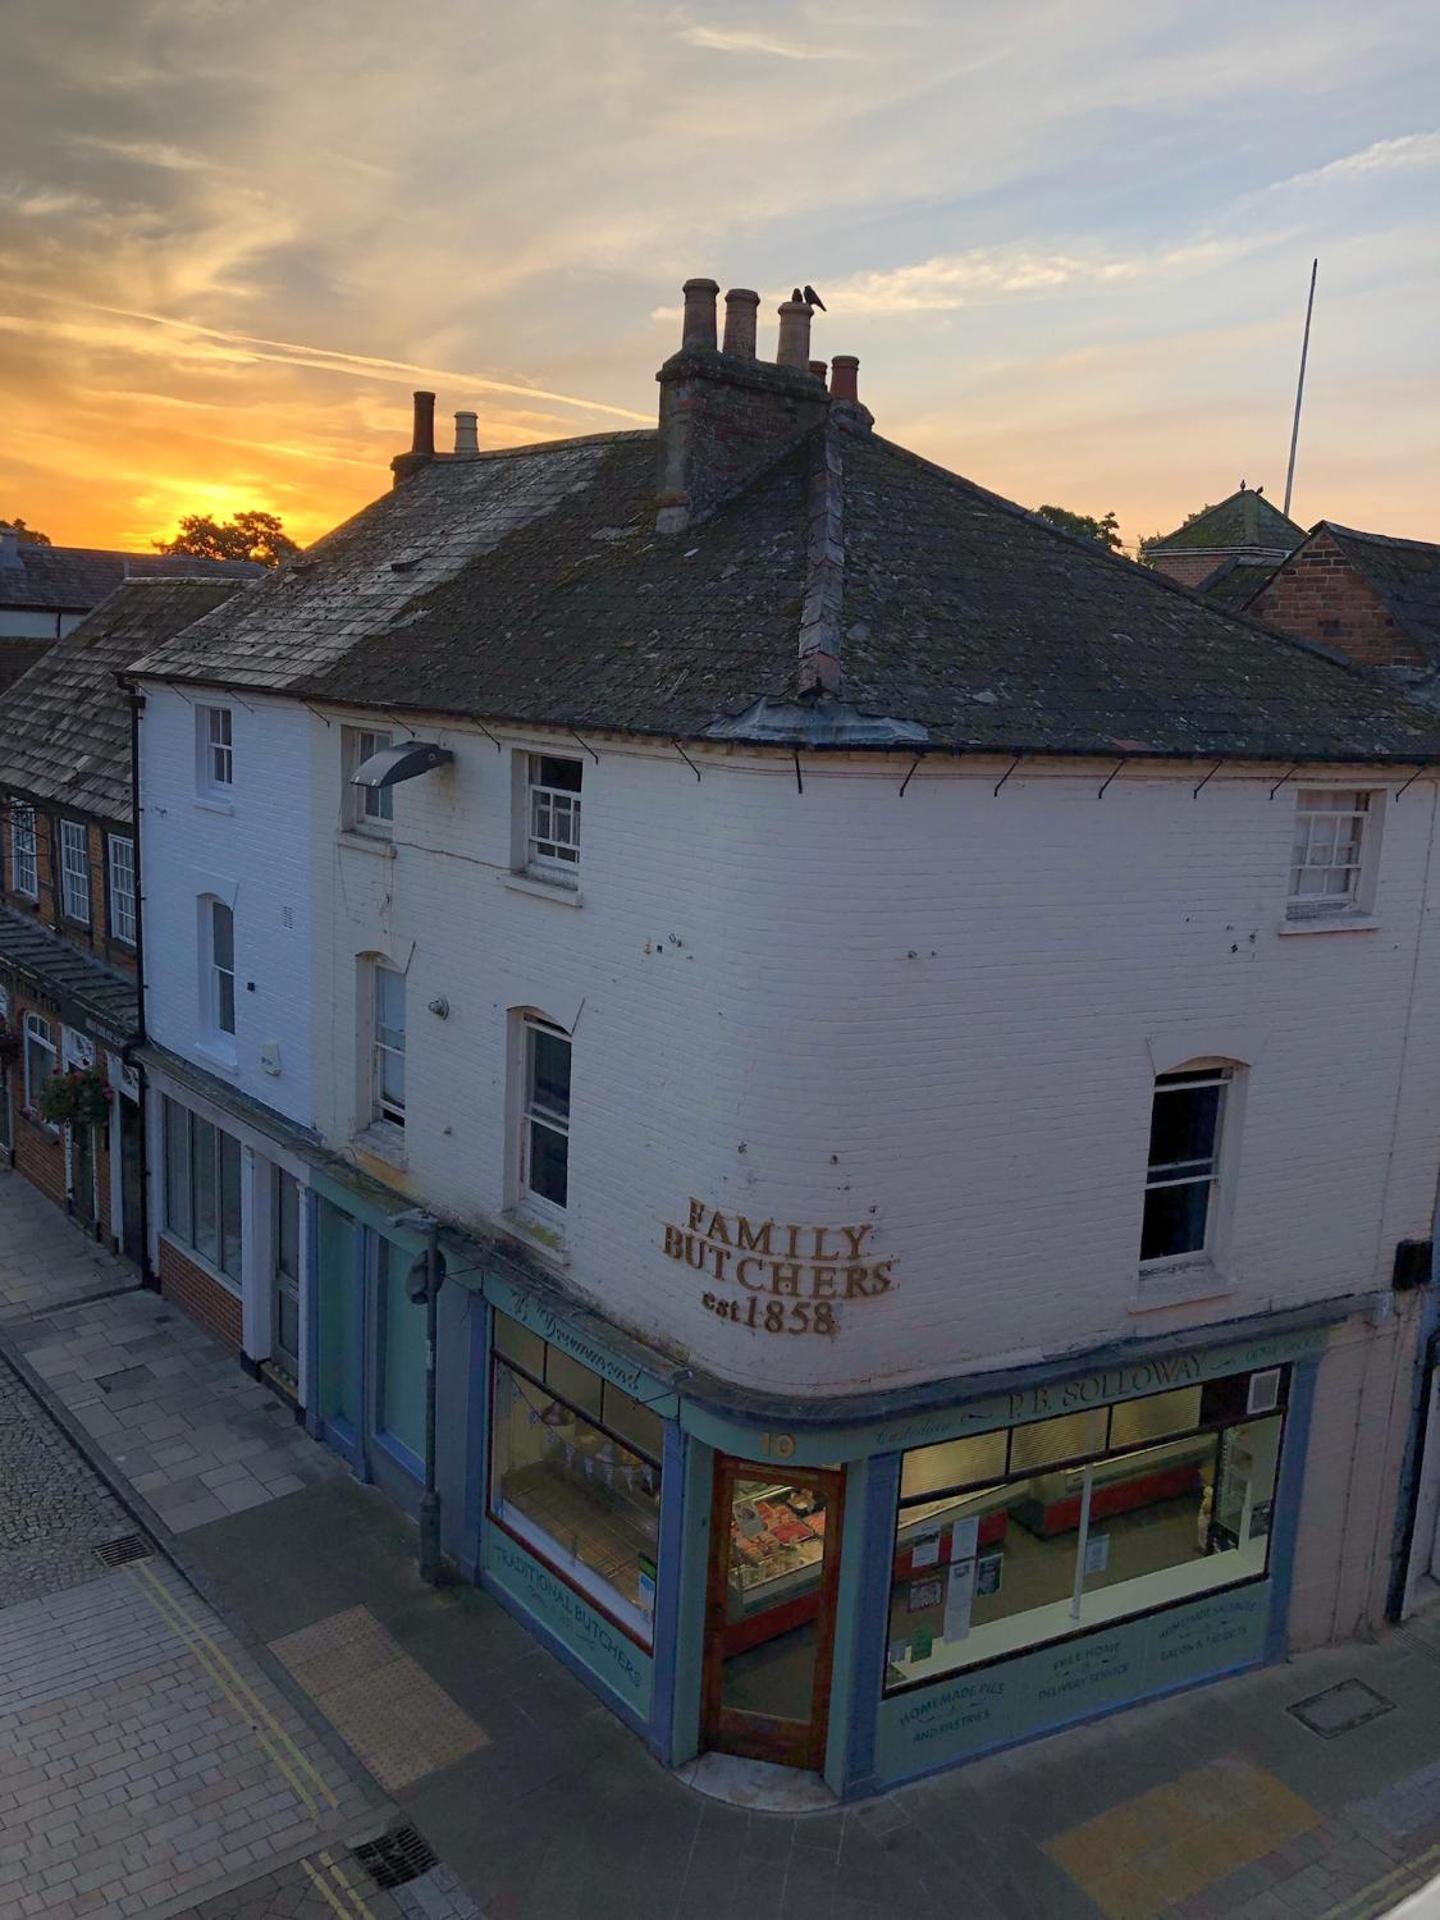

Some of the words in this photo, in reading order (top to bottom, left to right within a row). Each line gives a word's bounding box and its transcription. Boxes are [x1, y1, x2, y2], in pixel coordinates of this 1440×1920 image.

[688, 1196, 873, 1261] FAMILY
[663, 1223, 898, 1300] BUTCHERS
[746, 1295, 836, 1336] 1858
[1063, 1352, 1207, 1406] SOLLOWAY
[762, 1432, 796, 1459] 10
[494, 1545, 574, 1614] TRADITIONAL
[574, 1606, 642, 1688] BUTCHERS
